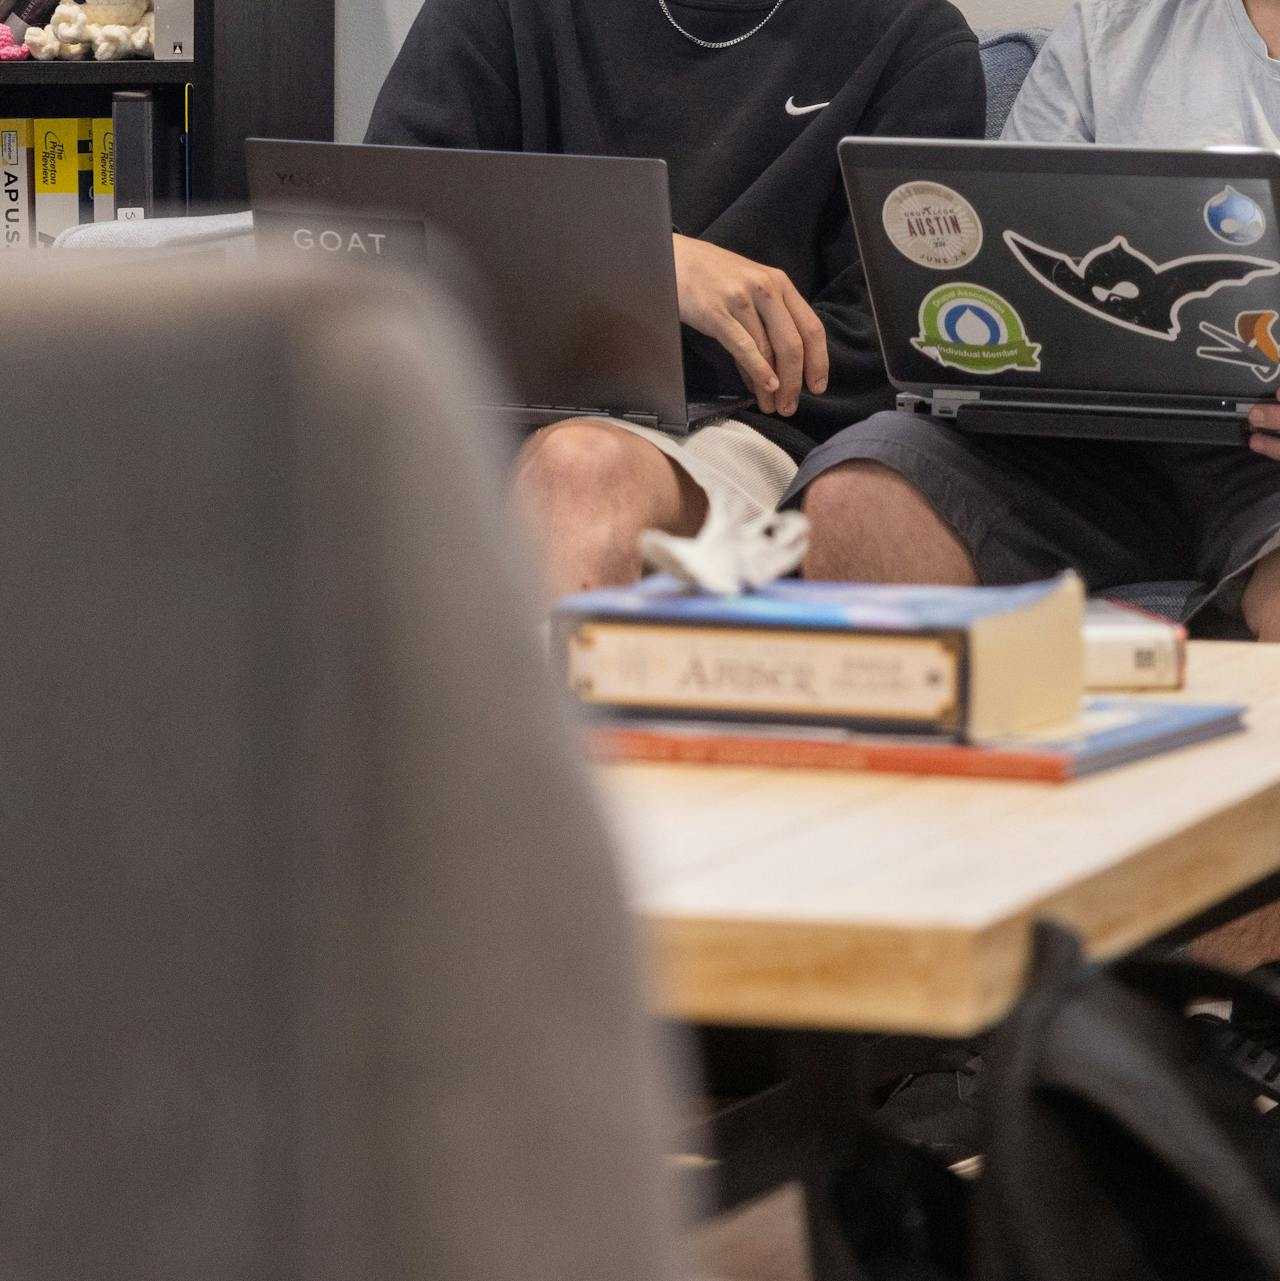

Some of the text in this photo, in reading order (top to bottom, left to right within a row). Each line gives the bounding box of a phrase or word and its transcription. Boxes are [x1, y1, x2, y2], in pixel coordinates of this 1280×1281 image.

[4, 170, 20, 248] AP U.S.
[907, 216, 962, 237] AUSTIN
[293, 228, 386, 254] GOAT
[920, 254, 949, 264] JUNE
[936, 344, 1018, 359] Individual Member
